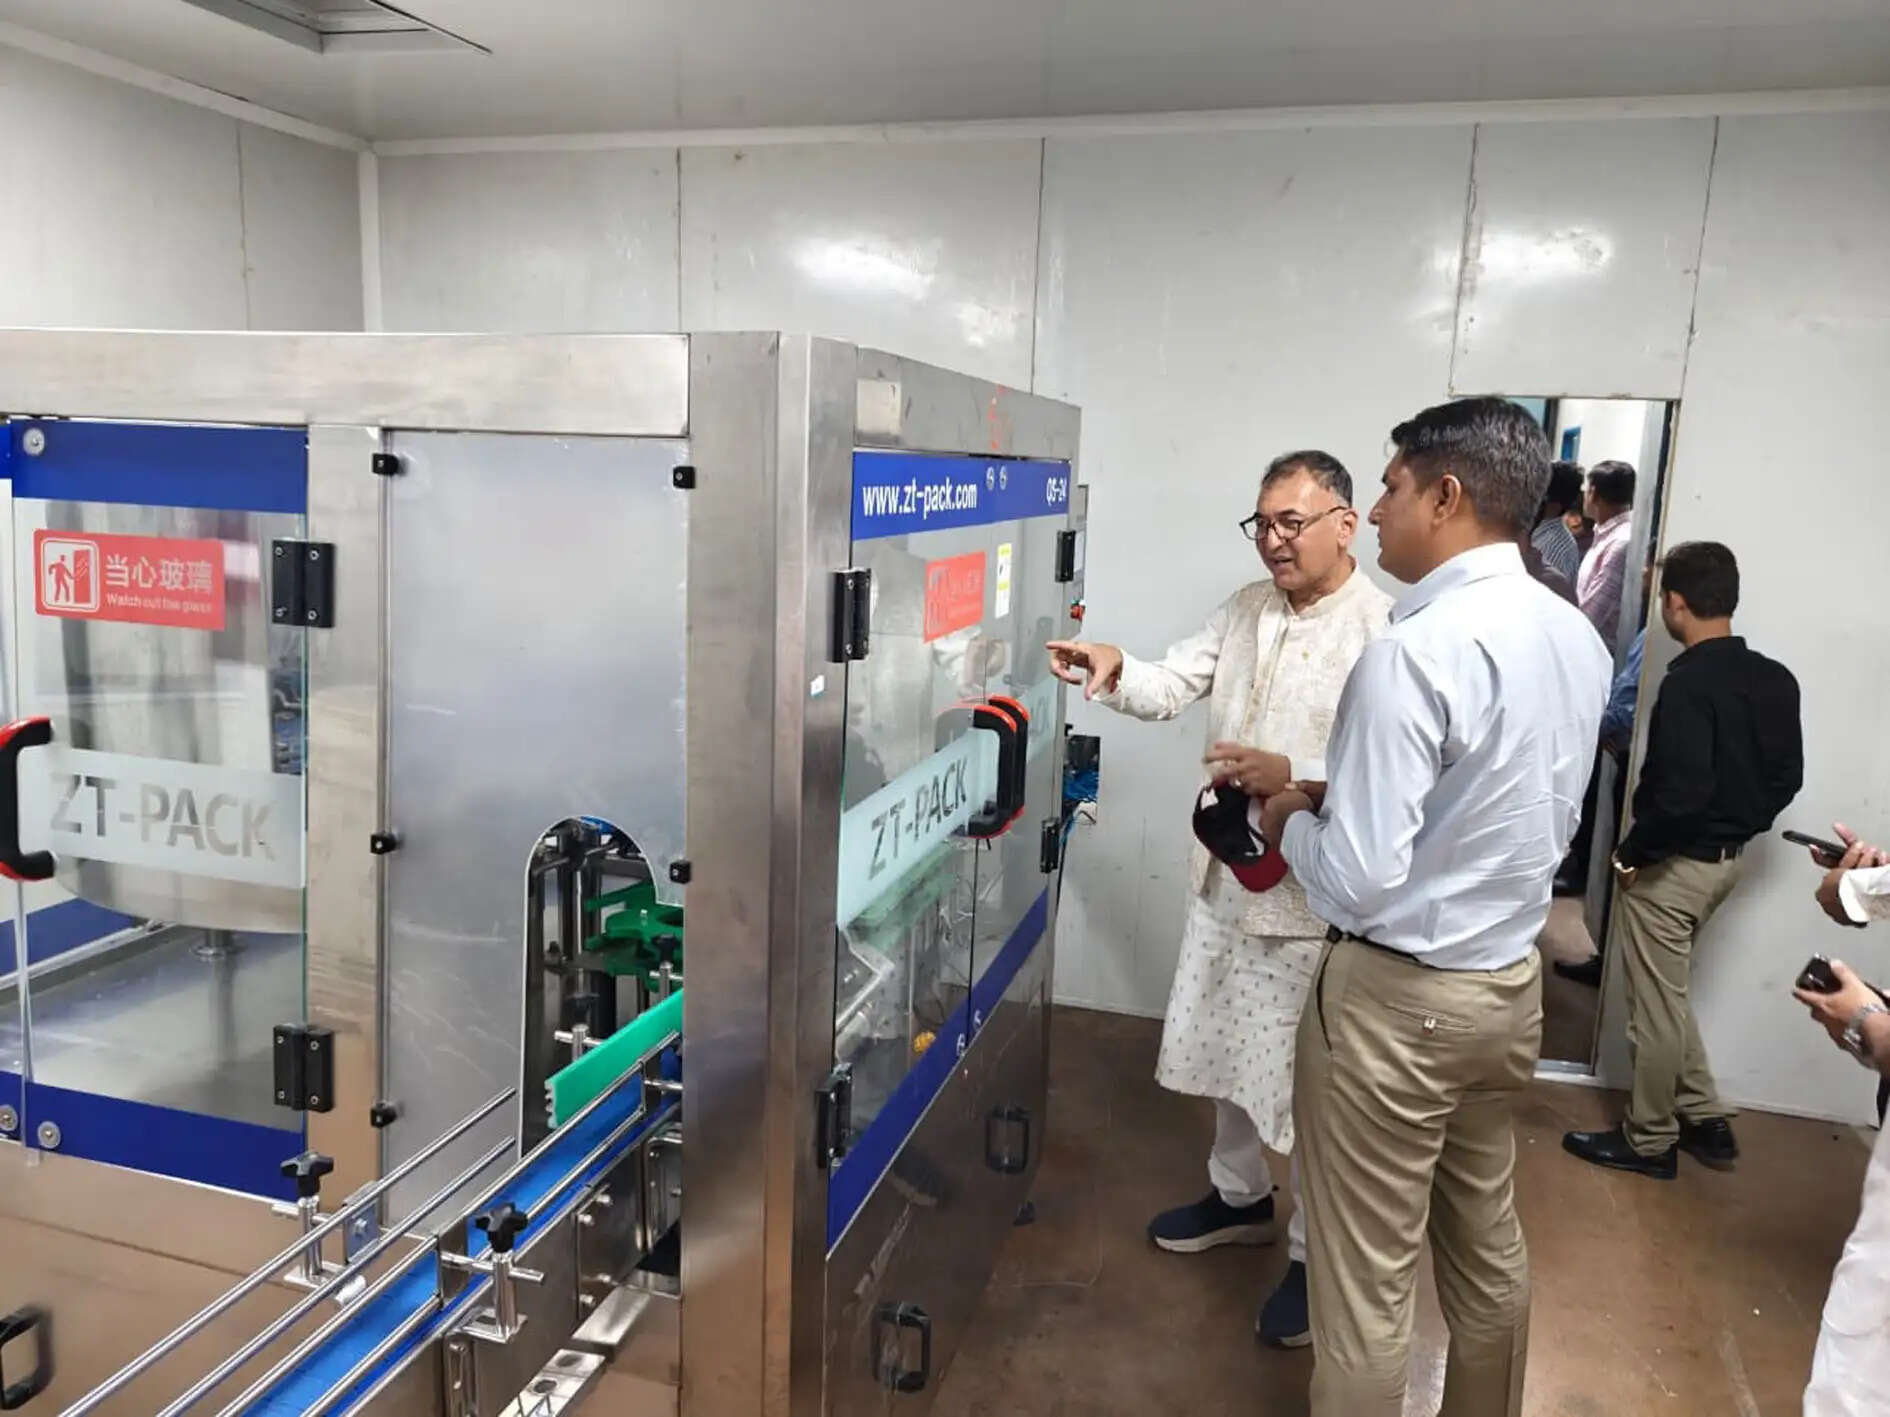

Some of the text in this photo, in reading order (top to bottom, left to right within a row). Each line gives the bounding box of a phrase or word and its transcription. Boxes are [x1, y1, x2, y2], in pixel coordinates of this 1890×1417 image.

[862, 476, 977, 520] www.zt-pack.com
[105, 553, 213, 595] 当心玻璃
[105, 592, 141, 608] Watch
[50, 773, 280, 861] ZT-PACK
[867, 754, 968, 880] ZT-PACK
